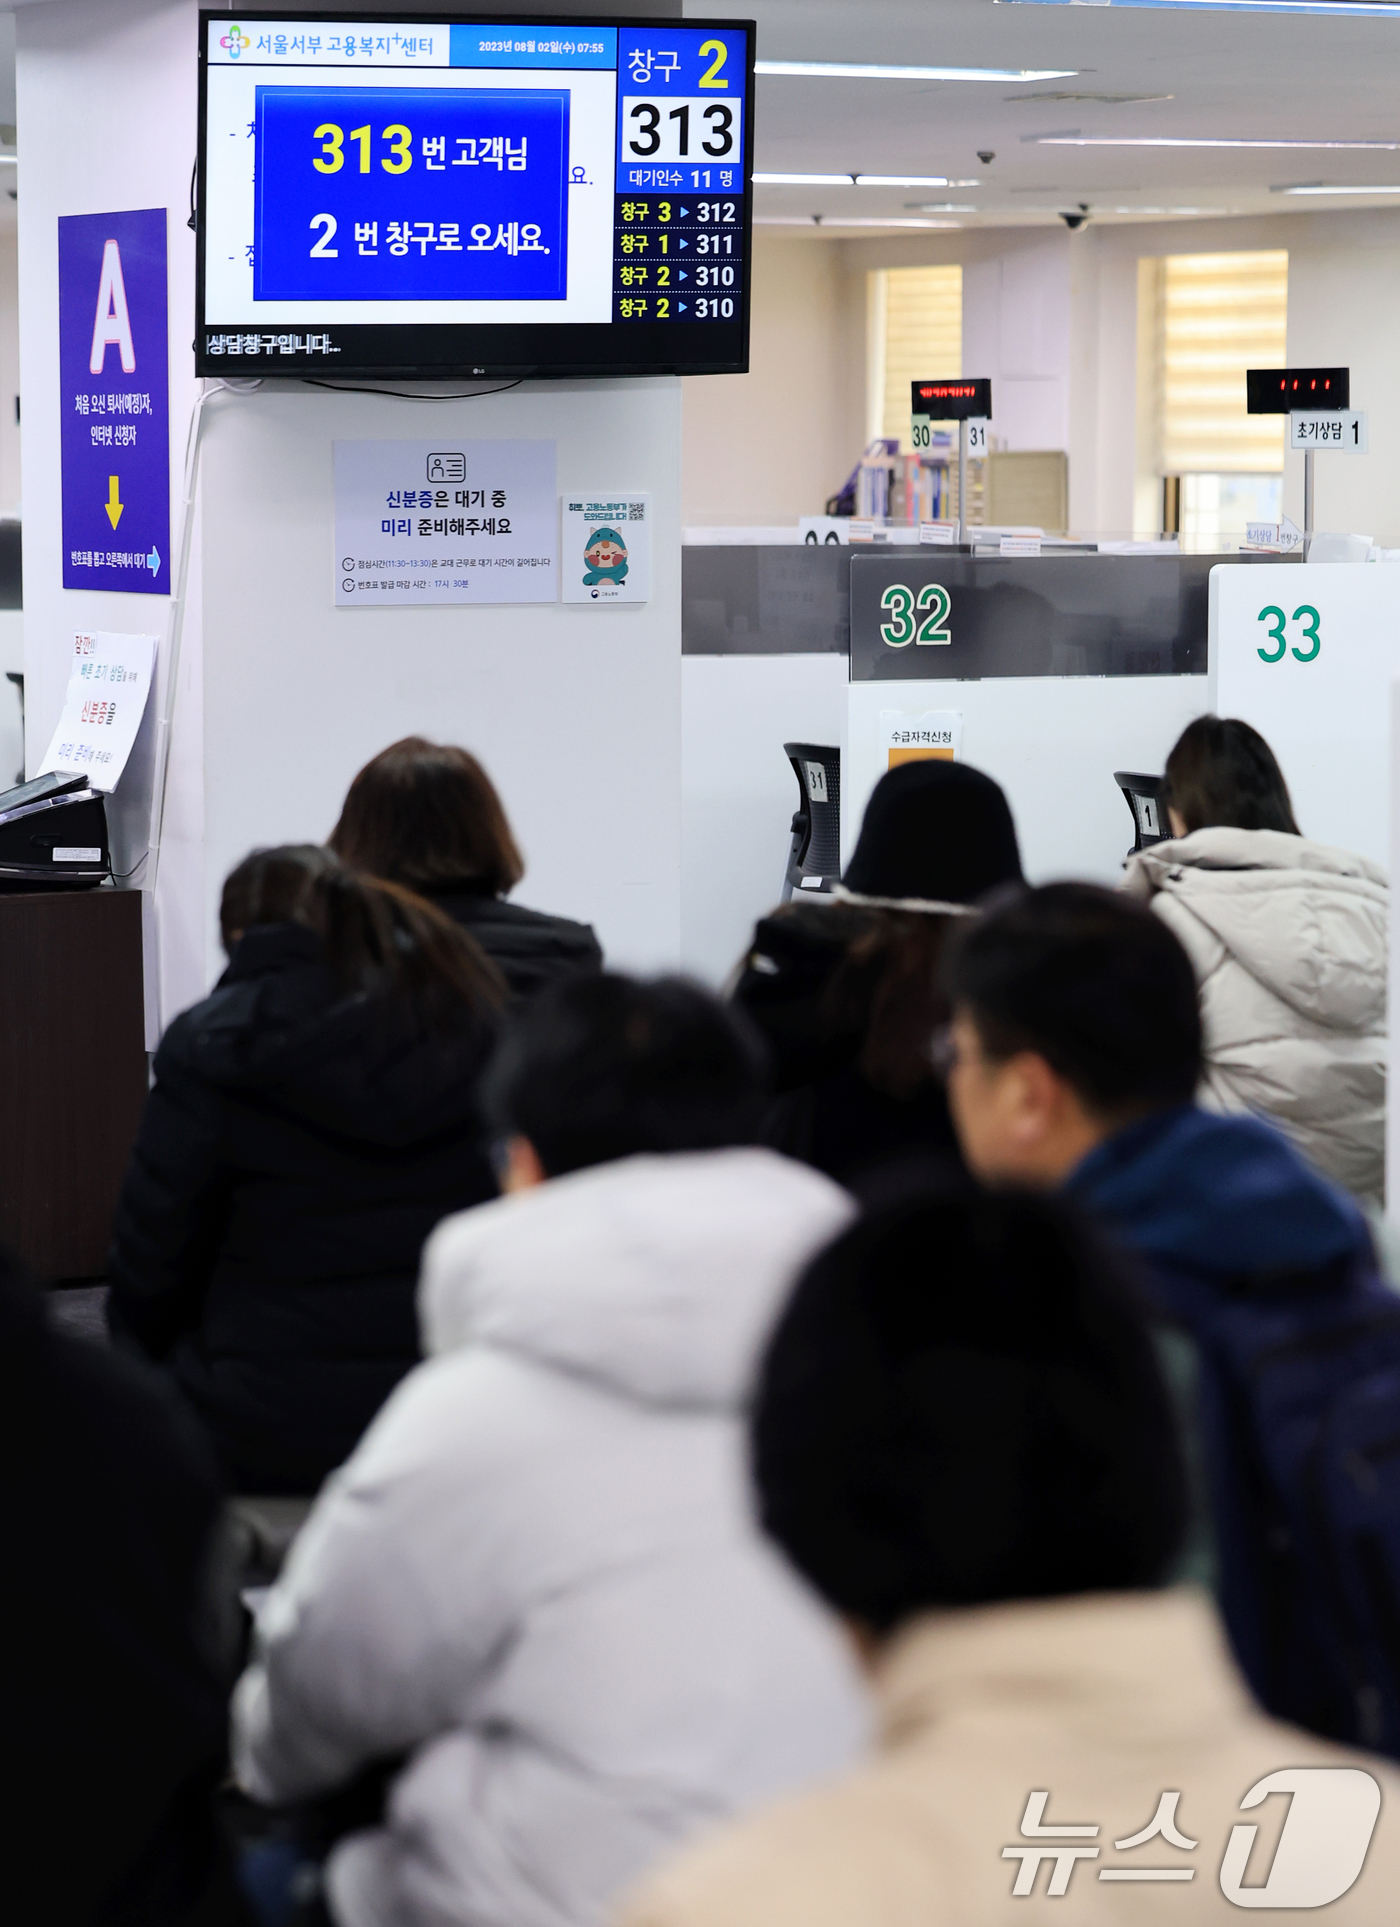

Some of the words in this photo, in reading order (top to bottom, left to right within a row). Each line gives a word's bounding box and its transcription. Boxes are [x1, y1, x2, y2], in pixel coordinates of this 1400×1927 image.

[256, 34, 323, 55] 서울서부
[479, 40, 512, 52] 2023년
[514, 40, 536, 53] 08월
[537, 41, 576, 54] 02일(수)
[577, 43, 604, 53] 07:55
[628, 48, 681, 83] 창구
[698, 39, 728, 88] 2
[629, 103, 733, 157] 313
[312, 123, 413, 175] 313
[422, 136, 446, 170] 번
[452, 136, 528, 171] 고객님
[629, 169, 683, 187] 대기인수
[691, 169, 711, 188] 11
[719, 170, 733, 188] 명
[621, 201, 650, 222] 창구
[658, 201, 672, 222] 3
[697, 202, 736, 222] 312
[309, 213, 339, 258] 2
[354, 221, 379, 256] 번
[385, 221, 463, 256] 창구로
[467, 221, 551, 256] 오세요.
[620, 234, 649, 254] 창구
[658, 234, 668, 254] 1
[696, 234, 732, 254] 311
[620, 266, 649, 286] 창구
[657, 266, 671, 286] 2
[695, 266, 735, 286] 310
[90, 239, 136, 375] A
[619, 298, 648, 318] 창구
[656, 298, 670, 318] 2
[695, 298, 734, 318] 310
[75, 394, 90, 415] 처음
[91, 394, 106, 415] 오신
[107, 393, 153, 416] 퇴사(예정)자,
[90, 425, 113, 446] 인터넷
[114, 425, 137, 446] 신청자
[913, 424, 930, 447] 30
[970, 426, 985, 446] 31
[1297, 421, 1343, 440] 초기상담
[1351, 421, 1360, 445] 1
[386, 490, 449, 508] 신분증은
[455, 490, 485, 508] 대기
[491, 490, 507, 508] 중
[381, 518, 411, 536] 미리
[417, 518, 512, 536] 준비해주세요
[71, 551, 93, 567] 번호표를
[93, 551, 105, 567] 뽑고
[106, 552, 133, 568] 오른쪽에서
[134, 553, 146, 569] 대기
[440, 559, 453, 568] 교대
[456, 559, 476, 568] 근무로
[479, 558, 493, 568] 대기
[494, 558, 515, 568] 시간이
[516, 558, 551, 567] 길어집니다
[358, 580, 379, 589] 번호표
[380, 580, 394, 589] 발급
[396, 580, 411, 589] 마감
[434, 579, 449, 588] 17시
[453, 579, 469, 589] 30분
[879, 583, 952, 648] 32
[1257, 605, 1321, 663] 33
[81, 663, 94, 680] 빠른
[94, 664, 108, 681] 초기
[81, 700, 116, 725] 신분증을
[891, 731, 952, 743] 수급자격신청
[810, 771, 823, 789] 31
[1144, 805, 1152, 828] 1
